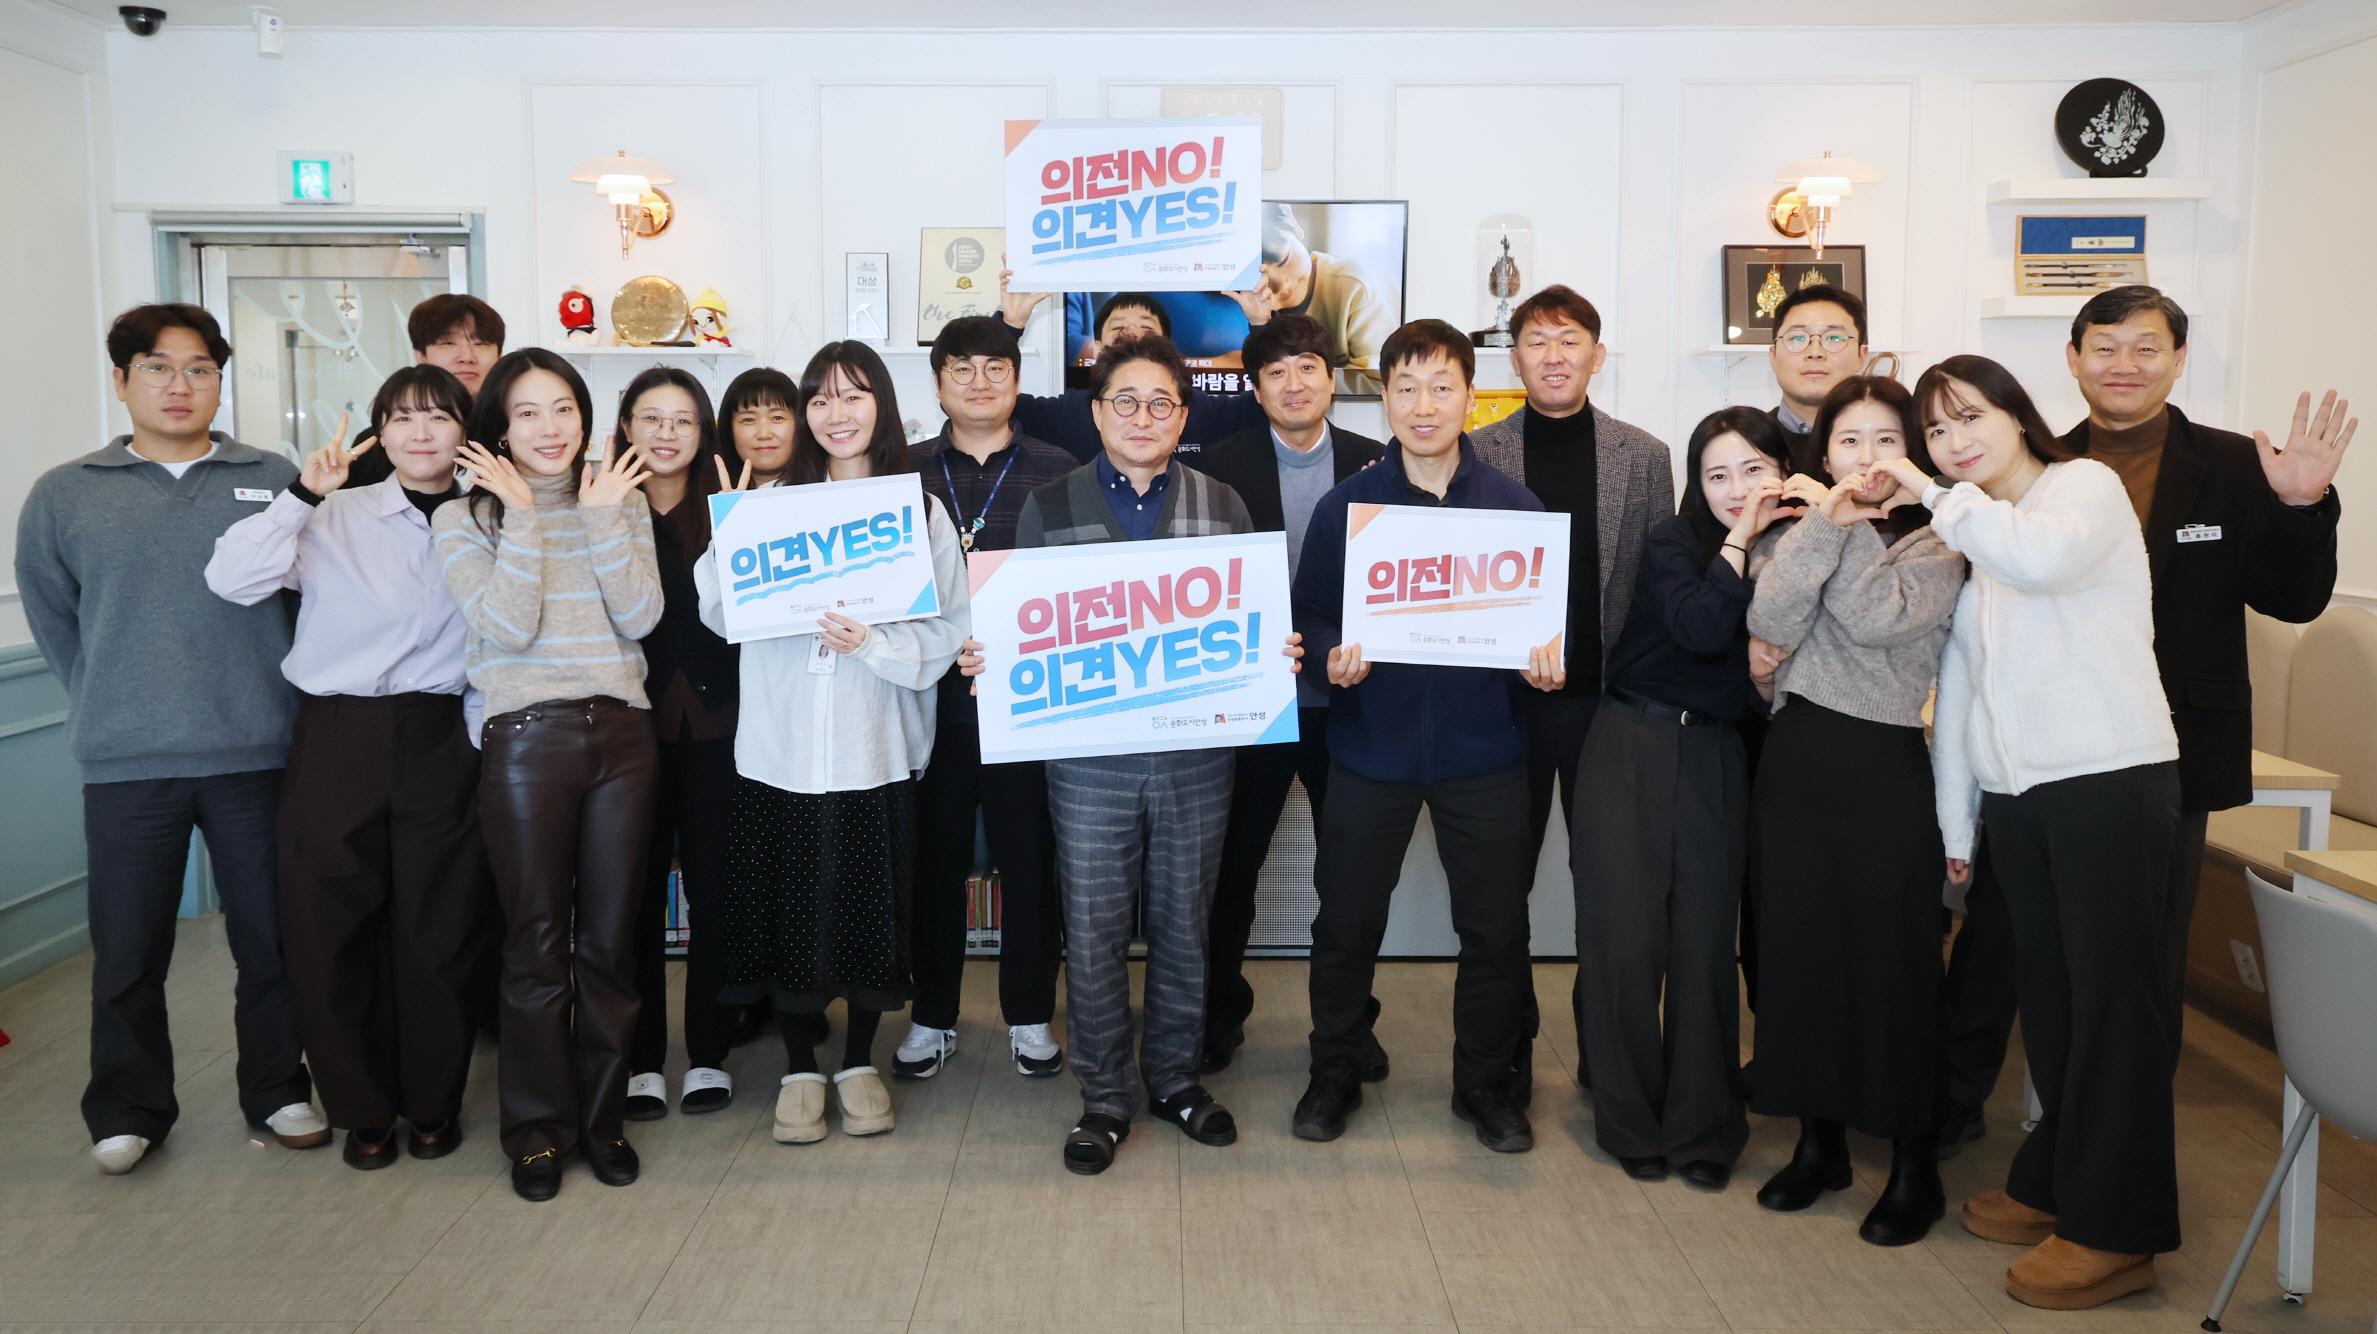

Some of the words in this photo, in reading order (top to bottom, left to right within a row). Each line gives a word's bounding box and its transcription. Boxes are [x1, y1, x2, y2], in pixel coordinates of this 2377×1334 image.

[1041, 136, 1225, 206] 의전NO!
[1031, 181, 1237, 255] 의견YES!
[857, 276, 877, 287] 대상
[1222, 263, 1236, 271] 안성
[1192, 373, 1240, 392] 바람을
[1198, 359, 1213, 368] 확대
[730, 505, 913, 593] 의견YES!
[1366, 546, 1545, 605] 의전NO!
[1018, 557, 1243, 655] 의전NO!
[1009, 611, 1262, 717] 의견YES!
[1170, 718, 1207, 728] 문화도시안성
[1249, 711, 1266, 720] 안성
